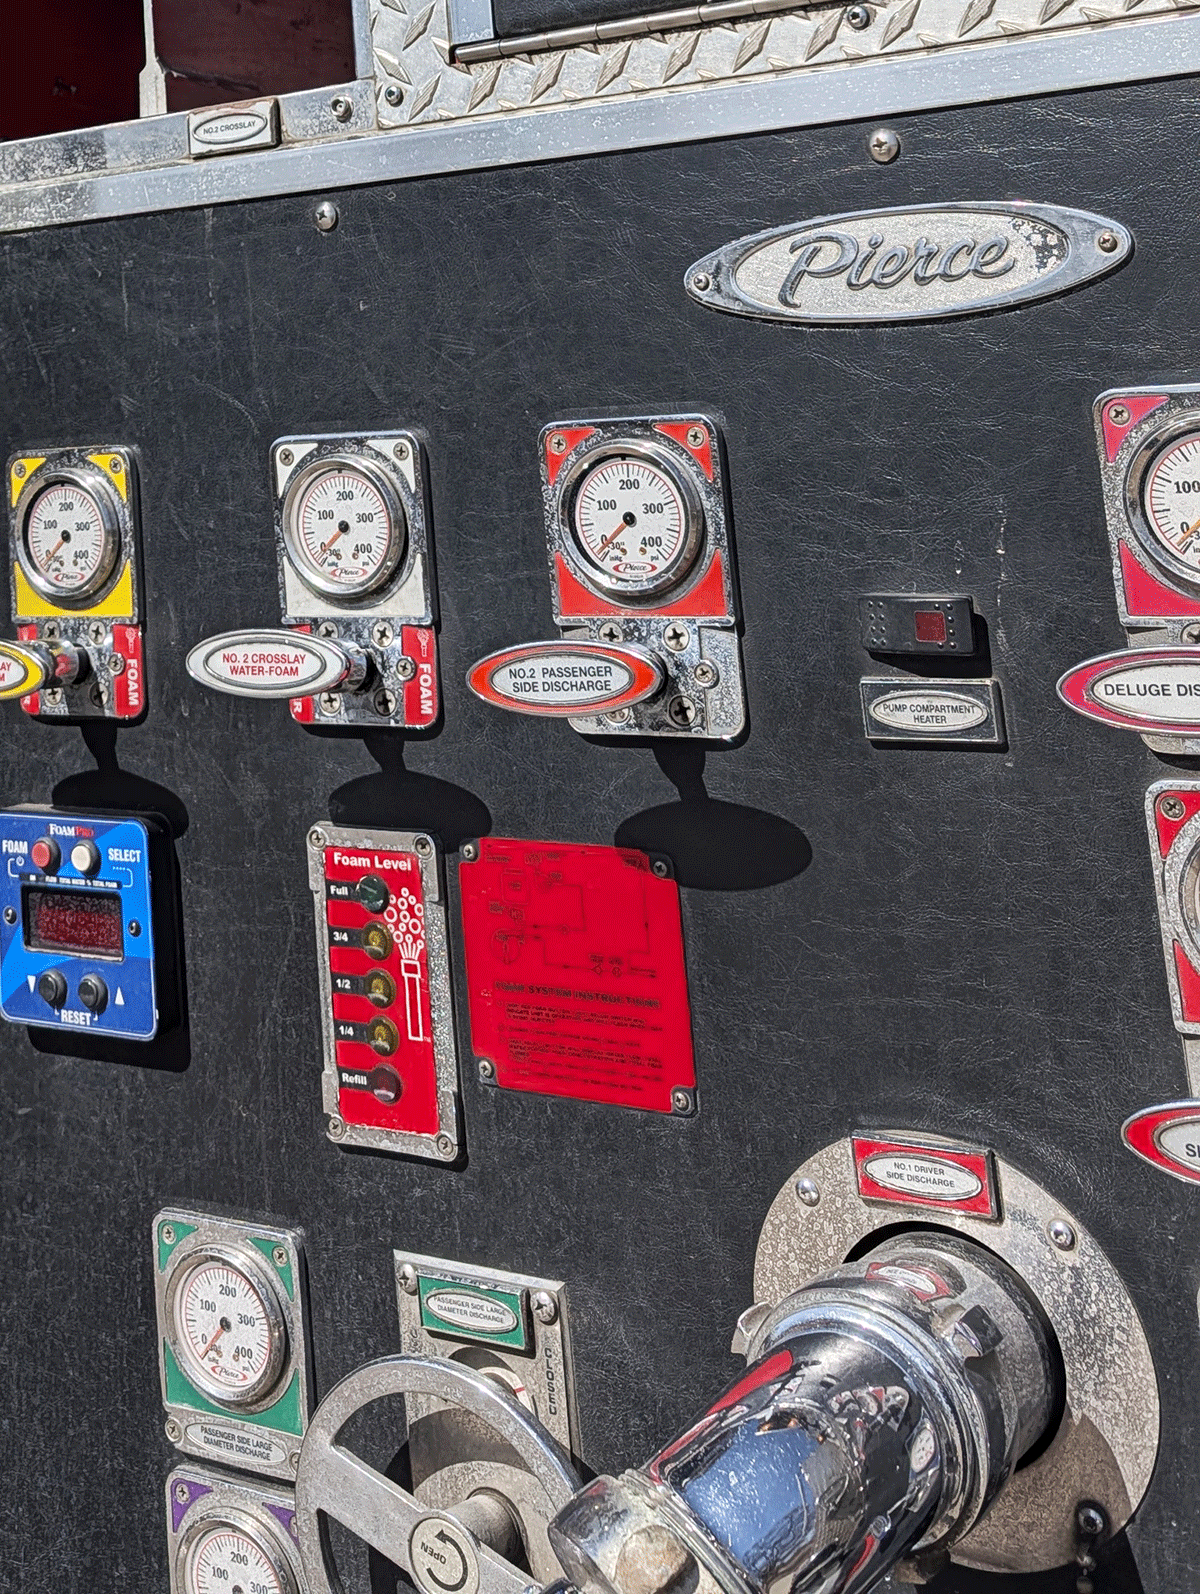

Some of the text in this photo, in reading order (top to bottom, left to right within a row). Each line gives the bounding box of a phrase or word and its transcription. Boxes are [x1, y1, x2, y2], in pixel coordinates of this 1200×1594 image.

[219, 120, 256, 132] CROSSLAY
[778, 231, 1016, 308] Pierce
[619, 479, 640, 490] 200
[1174, 481, 1200, 494] 100
[336, 490, 354, 501] 200
[59, 502, 74, 511] 200
[597, 499, 617, 511] 100
[643, 503, 663, 514] 300
[317, 510, 334, 520] 100
[355, 513, 374, 523] 300
[43, 519, 57, 530] 100
[75, 521, 90, 531] 300
[641, 536, 662, 547] 400
[74, 549, 89, 560] 400
[354, 543, 372, 554] 400
[222, 653, 306, 665] NO. 2 CROSSLAY
[229, 665, 299, 676] WATER-FOAM
[509, 666, 613, 679] NO.2 PASSENGER
[127, 658, 139, 706] FOAM
[512, 680, 612, 693] SIDE DISCHARGE
[419, 664, 432, 715] FOAM
[1104, 684, 1172, 696] DELUGE
[883, 704, 975, 713] PUMP COMPARTMENT
[913, 715, 947, 724] HEATER
[2, 840, 28, 854] FOAM
[108, 848, 141, 863] SELECT
[334, 852, 412, 871] Foam Level
[330, 885, 348, 895] Full
[333, 932, 348, 942] 3/4
[336, 979, 351, 989] 1/2
[61, 1009, 91, 1025] RESET
[339, 1026, 354, 1036] 1/4
[342, 1073, 367, 1085] Refill
[894, 1161, 945, 1176] NO.1 DRIVER
[886, 1171, 955, 1188] SIDE DISCHARGE
[219, 1284, 236, 1298] 200
[200, 1299, 216, 1312] 100
[434, 1296, 506, 1317] PASSENGER SIDE LARGE
[238, 1313, 255, 1327] 300
[437, 1305, 504, 1324] DIAMETER DISCHARGE
[201, 1333, 208, 1344] 0
[234, 1346, 253, 1359] 400
[544, 1347, 557, 1416] CLOSED
[201, 1425, 273, 1452] PASSENGER SIDE LARGE
[203, 1436, 271, 1461] DIAMETER DISCHARGE
[230, 1551, 248, 1566] 200
[421, 1541, 447, 1565] OPEN
[212, 1566, 228, 1580] 100
[250, 1581, 268, 1594] 300
